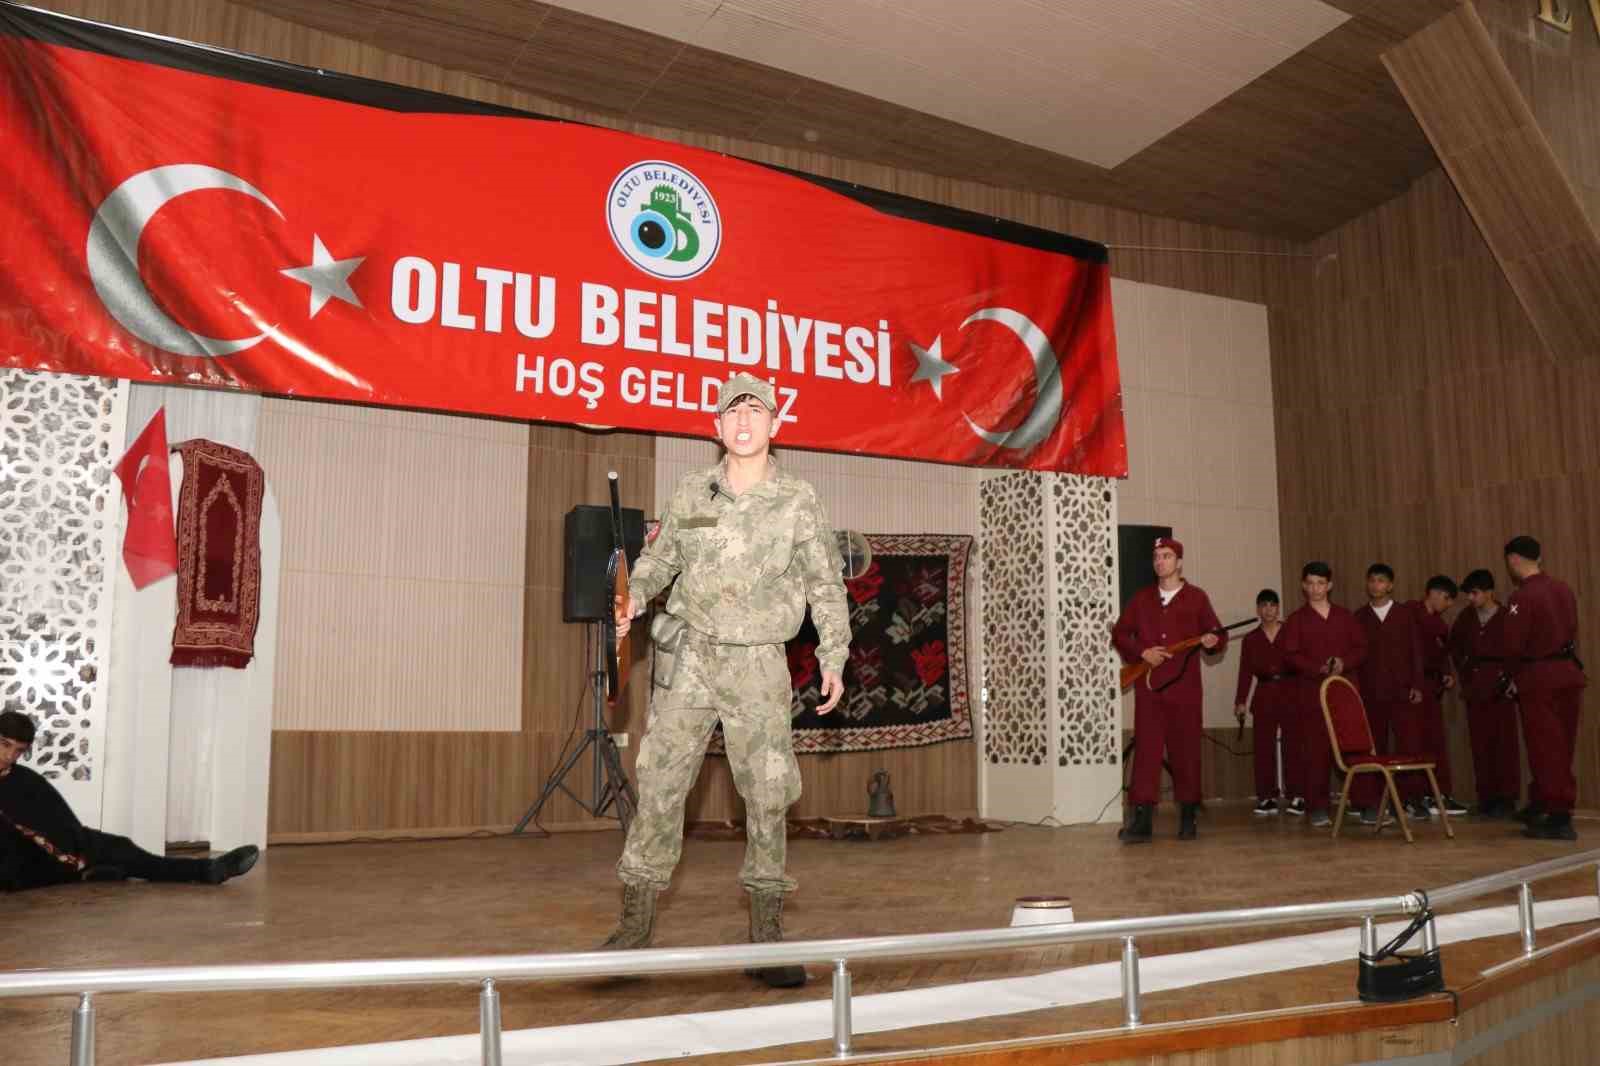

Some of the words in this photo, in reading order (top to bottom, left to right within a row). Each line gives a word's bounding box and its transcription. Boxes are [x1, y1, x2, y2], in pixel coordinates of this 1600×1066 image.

[617, 175, 641, 208] OLTU
[391, 256, 556, 339] OLTU
[581, 281, 892, 387] BELEDİYESİ
[515, 353, 605, 409] HOŞ
[620, 366, 798, 423] GELDZ
